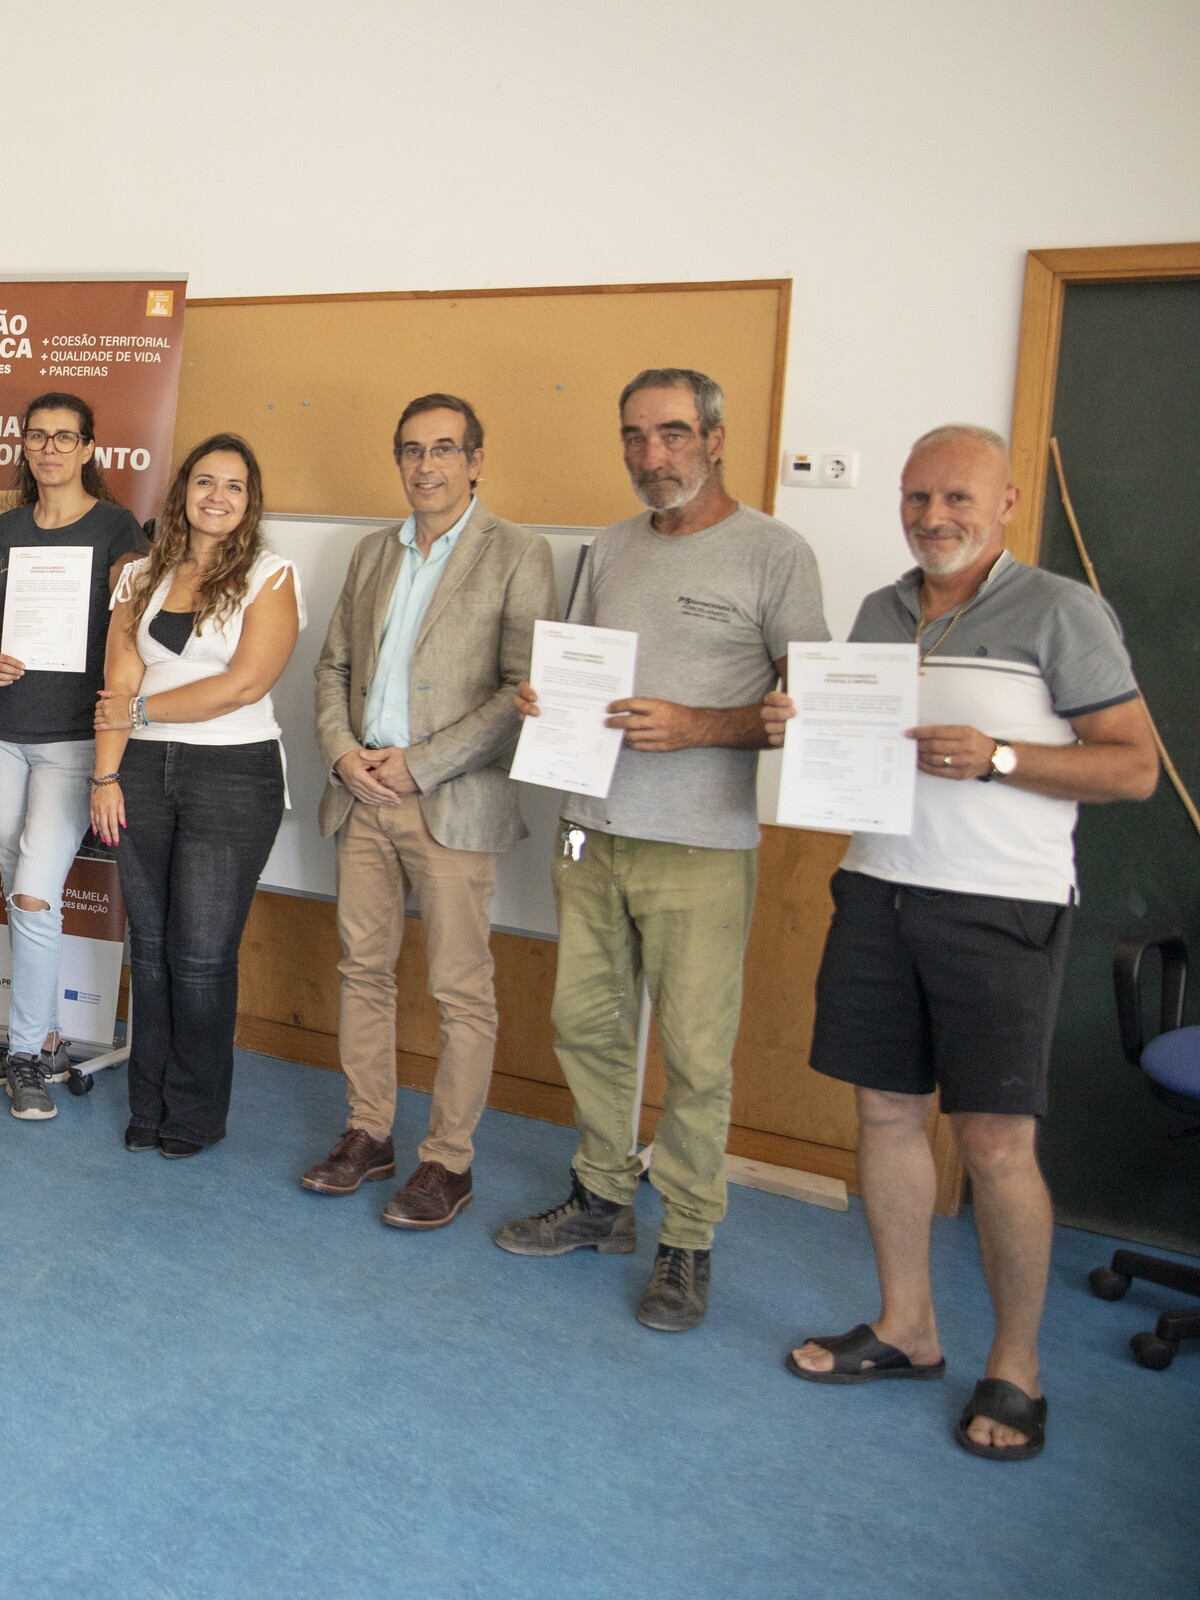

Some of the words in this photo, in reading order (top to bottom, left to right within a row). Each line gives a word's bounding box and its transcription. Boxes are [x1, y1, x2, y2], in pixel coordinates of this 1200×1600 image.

[51, 333, 97, 347] COESÃO
[99, 335, 171, 349] TERRITORIAL
[50, 350, 113, 362] QUALIDADE
[115, 351, 131, 362] DE
[133, 351, 161, 363] VIDA
[48, 365, 109, 377] PARCERIAS
[65, 888, 110, 903] PALMELA
[76, 902, 87, 911] EM
[87, 904, 108, 914] AÇÃO
